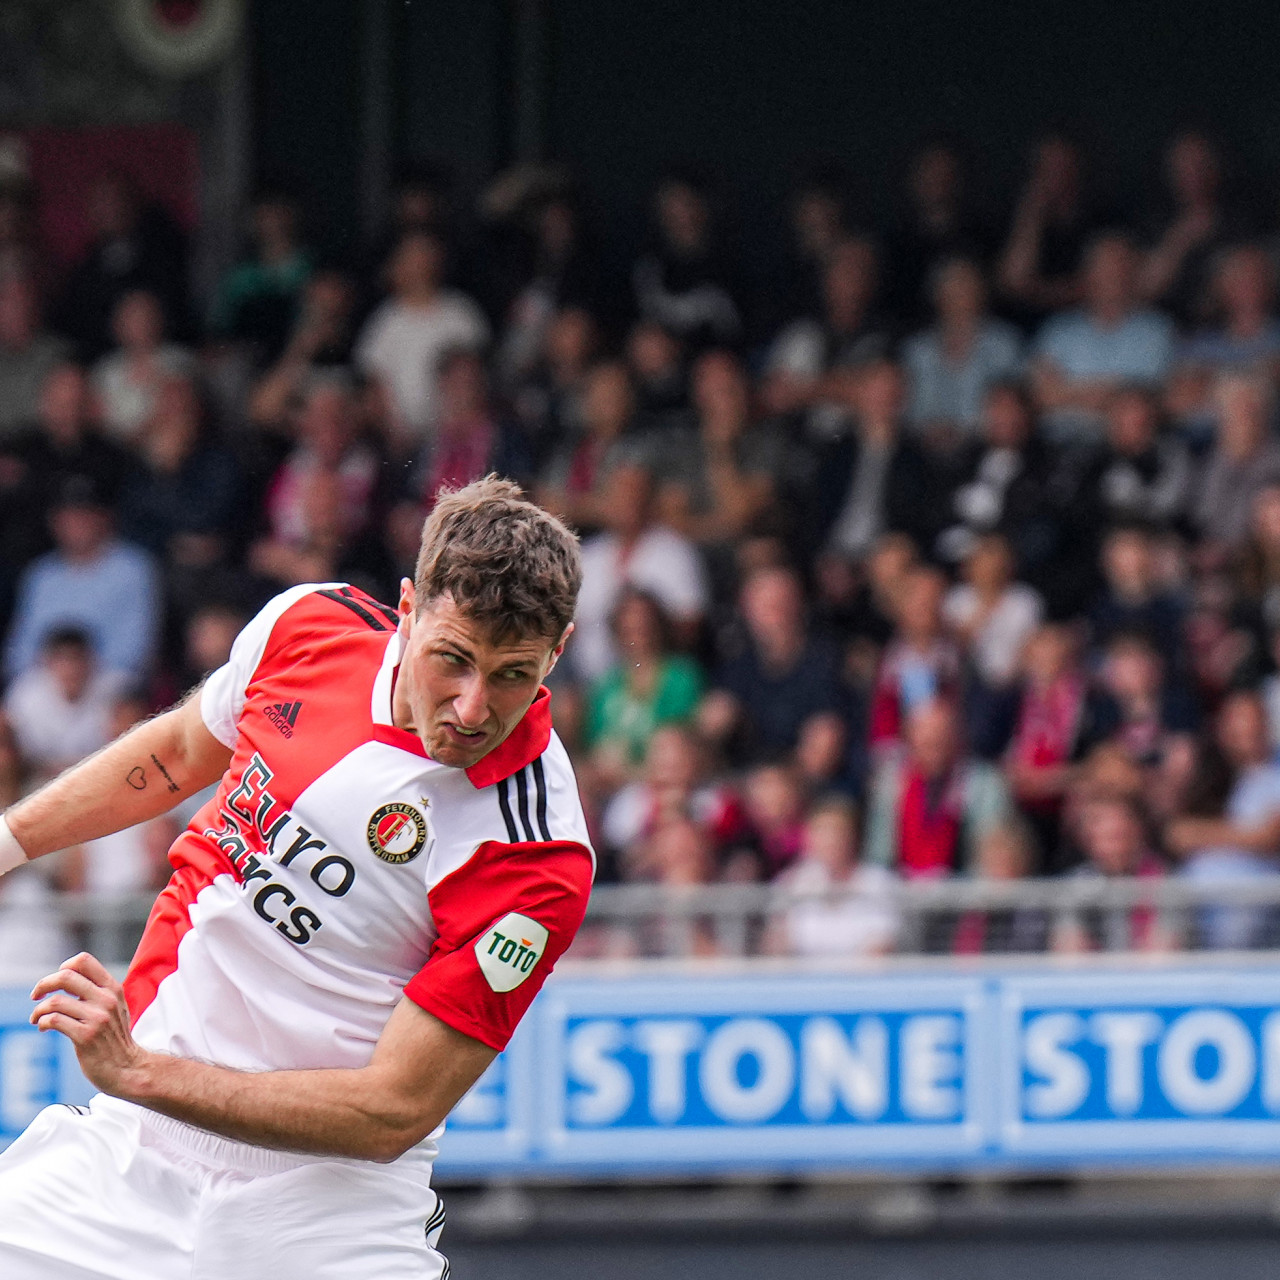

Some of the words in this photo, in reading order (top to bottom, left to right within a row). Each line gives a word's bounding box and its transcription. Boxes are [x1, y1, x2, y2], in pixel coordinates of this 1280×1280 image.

[263, 706, 293, 739] adidas
[227, 752, 355, 898] Euro
[368, 823, 410, 863] ROTTERDAM
[385, 804, 426, 843] FEYENOORD
[488, 931, 537, 973] TOTO
[566, 1017, 962, 1123] STONE
